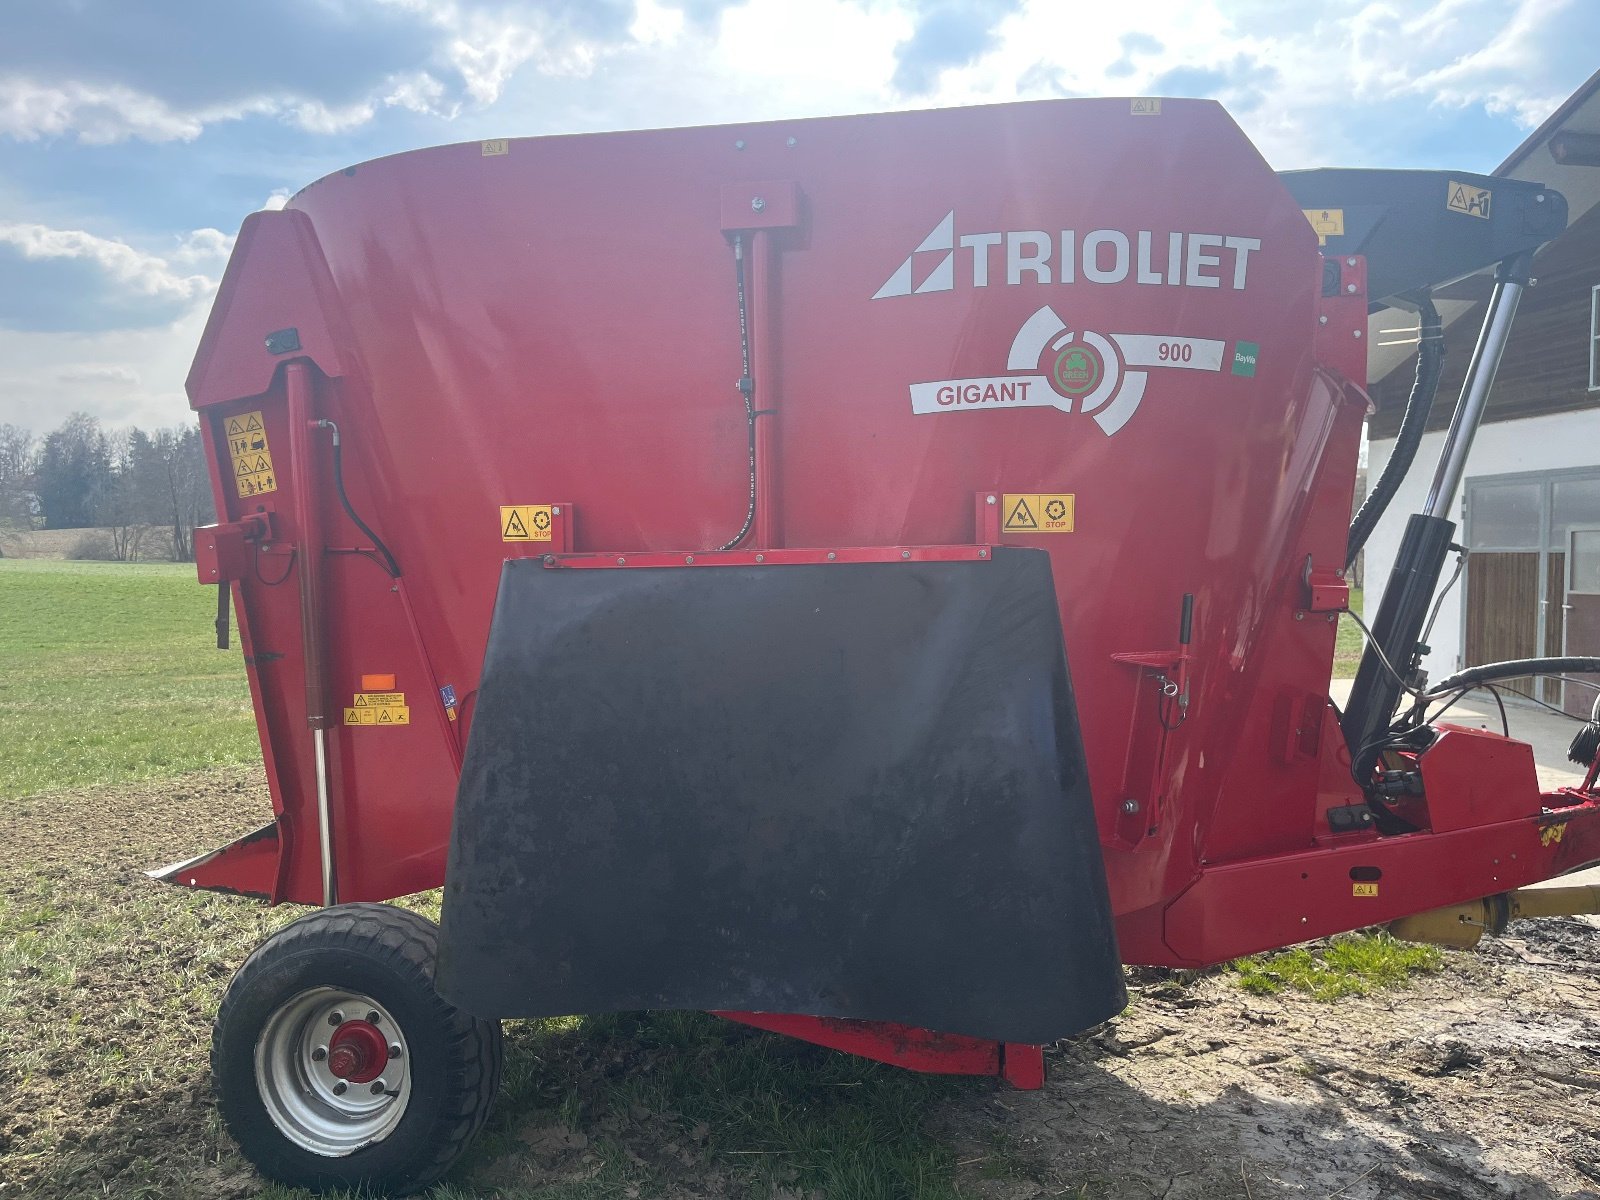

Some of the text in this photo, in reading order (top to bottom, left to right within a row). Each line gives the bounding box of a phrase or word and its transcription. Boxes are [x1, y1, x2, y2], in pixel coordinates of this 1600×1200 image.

[960, 230, 1261, 290] TRIOLIET
[1158, 343, 1192, 362] 900
[1235, 352, 1256, 364] BayWa
[936, 381, 1032, 406] GIGANT
